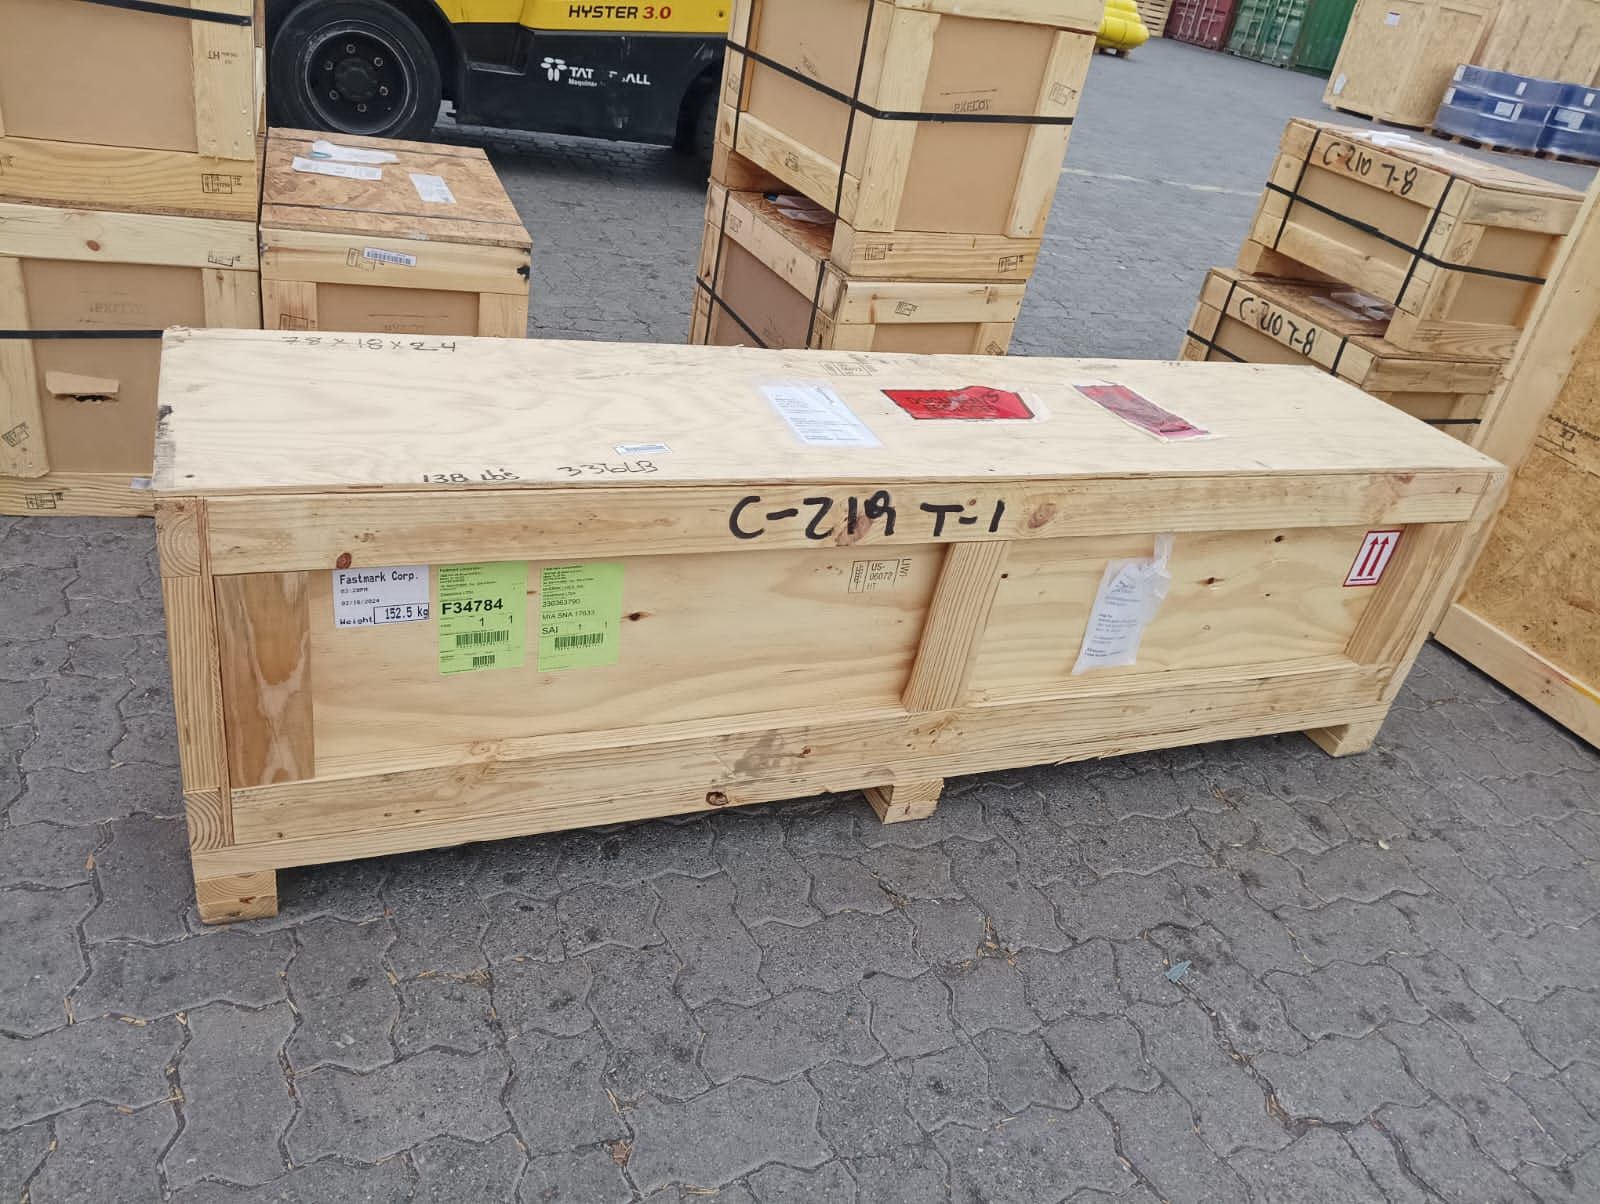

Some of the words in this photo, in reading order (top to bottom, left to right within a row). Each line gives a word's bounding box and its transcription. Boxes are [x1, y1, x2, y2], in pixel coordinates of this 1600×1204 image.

[569, 5, 638, 19] HYSTER
[642, 6, 672, 20] 3.0
[423, 473, 469, 483] 138
[729, 490, 897, 540] C-219
[920, 499, 1006, 537] T-1
[340, 573, 387, 585] Fastmark
[391, 571, 419, 583] Corp.
[441, 598, 504, 615] F34784
[340, 615, 373, 625] Weight
[385, 606, 413, 620] 152.5
[417, 605, 430, 619] kg
